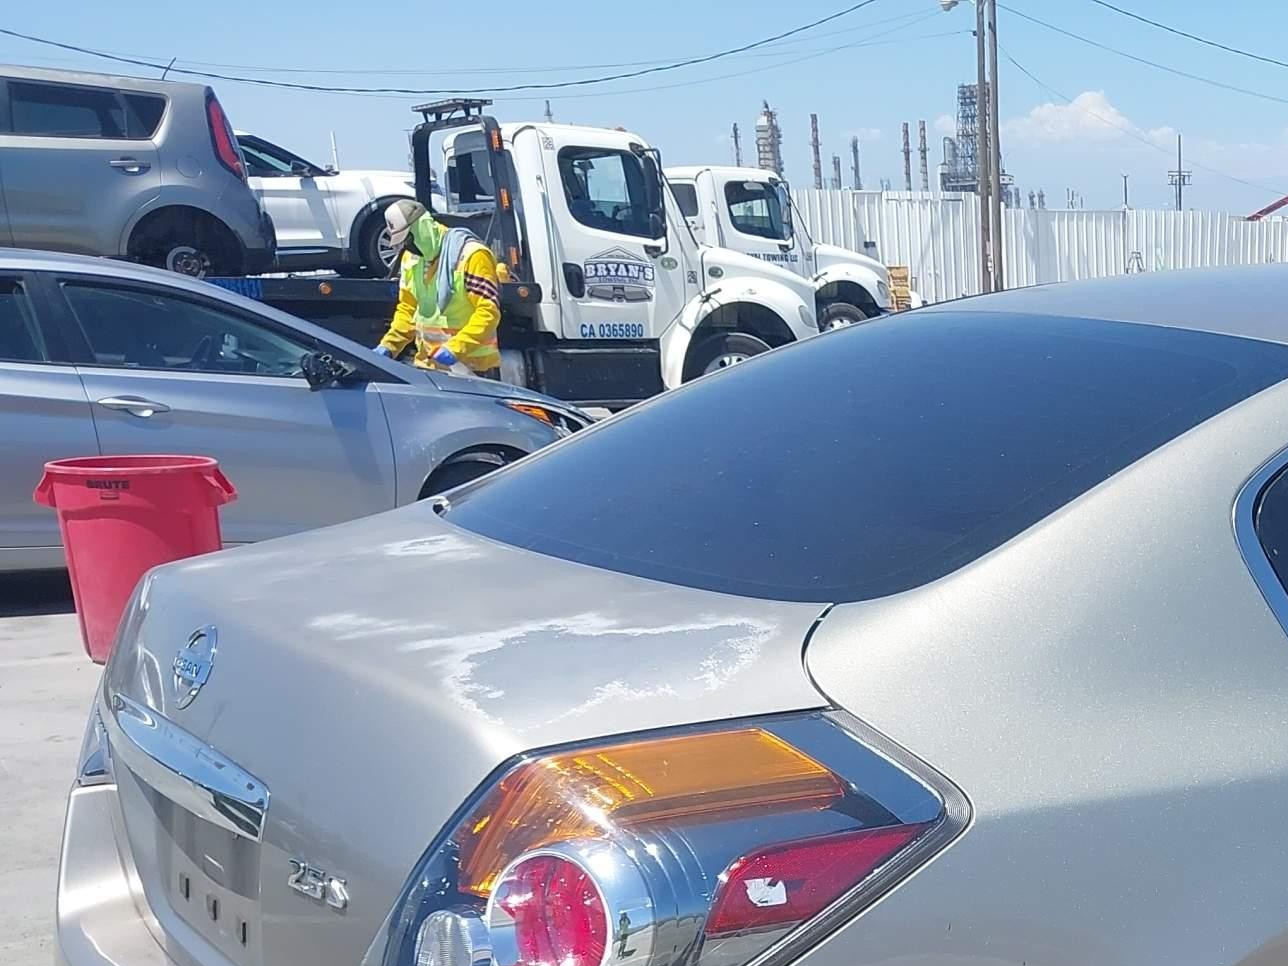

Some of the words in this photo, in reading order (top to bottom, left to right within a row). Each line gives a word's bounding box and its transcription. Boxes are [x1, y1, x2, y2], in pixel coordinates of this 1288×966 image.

[762, 253, 789, 263] TOWING
[585, 262, 655, 281] BRYAN'S
[580, 324, 596, 338] CA
[598, 324, 644, 338] 0365890
[86, 480, 129, 489] BRUTE
